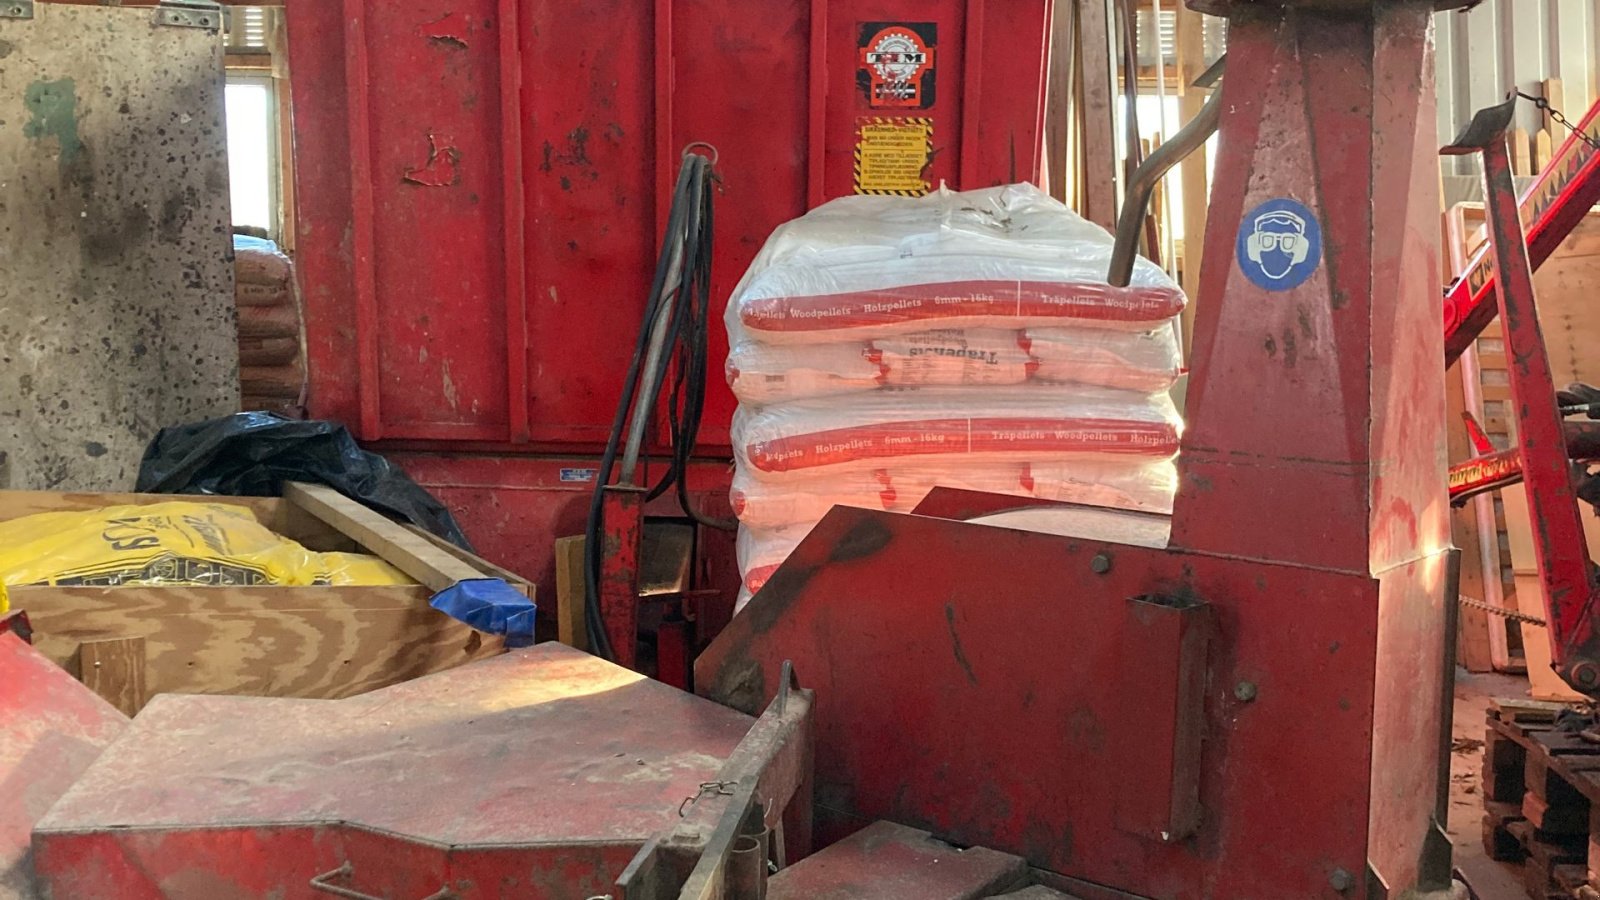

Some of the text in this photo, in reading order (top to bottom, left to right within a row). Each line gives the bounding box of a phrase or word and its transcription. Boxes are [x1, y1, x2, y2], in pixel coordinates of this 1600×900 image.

[790, 307, 851, 320] Woodpellets
[864, 299, 922, 313] Holzpellets
[815, 438, 873, 454] Holzpellets
[884, 435, 912, 445] 6mm
[920, 433, 945, 443] 16kg
[1054, 430, 1118, 442] Woodpellets
